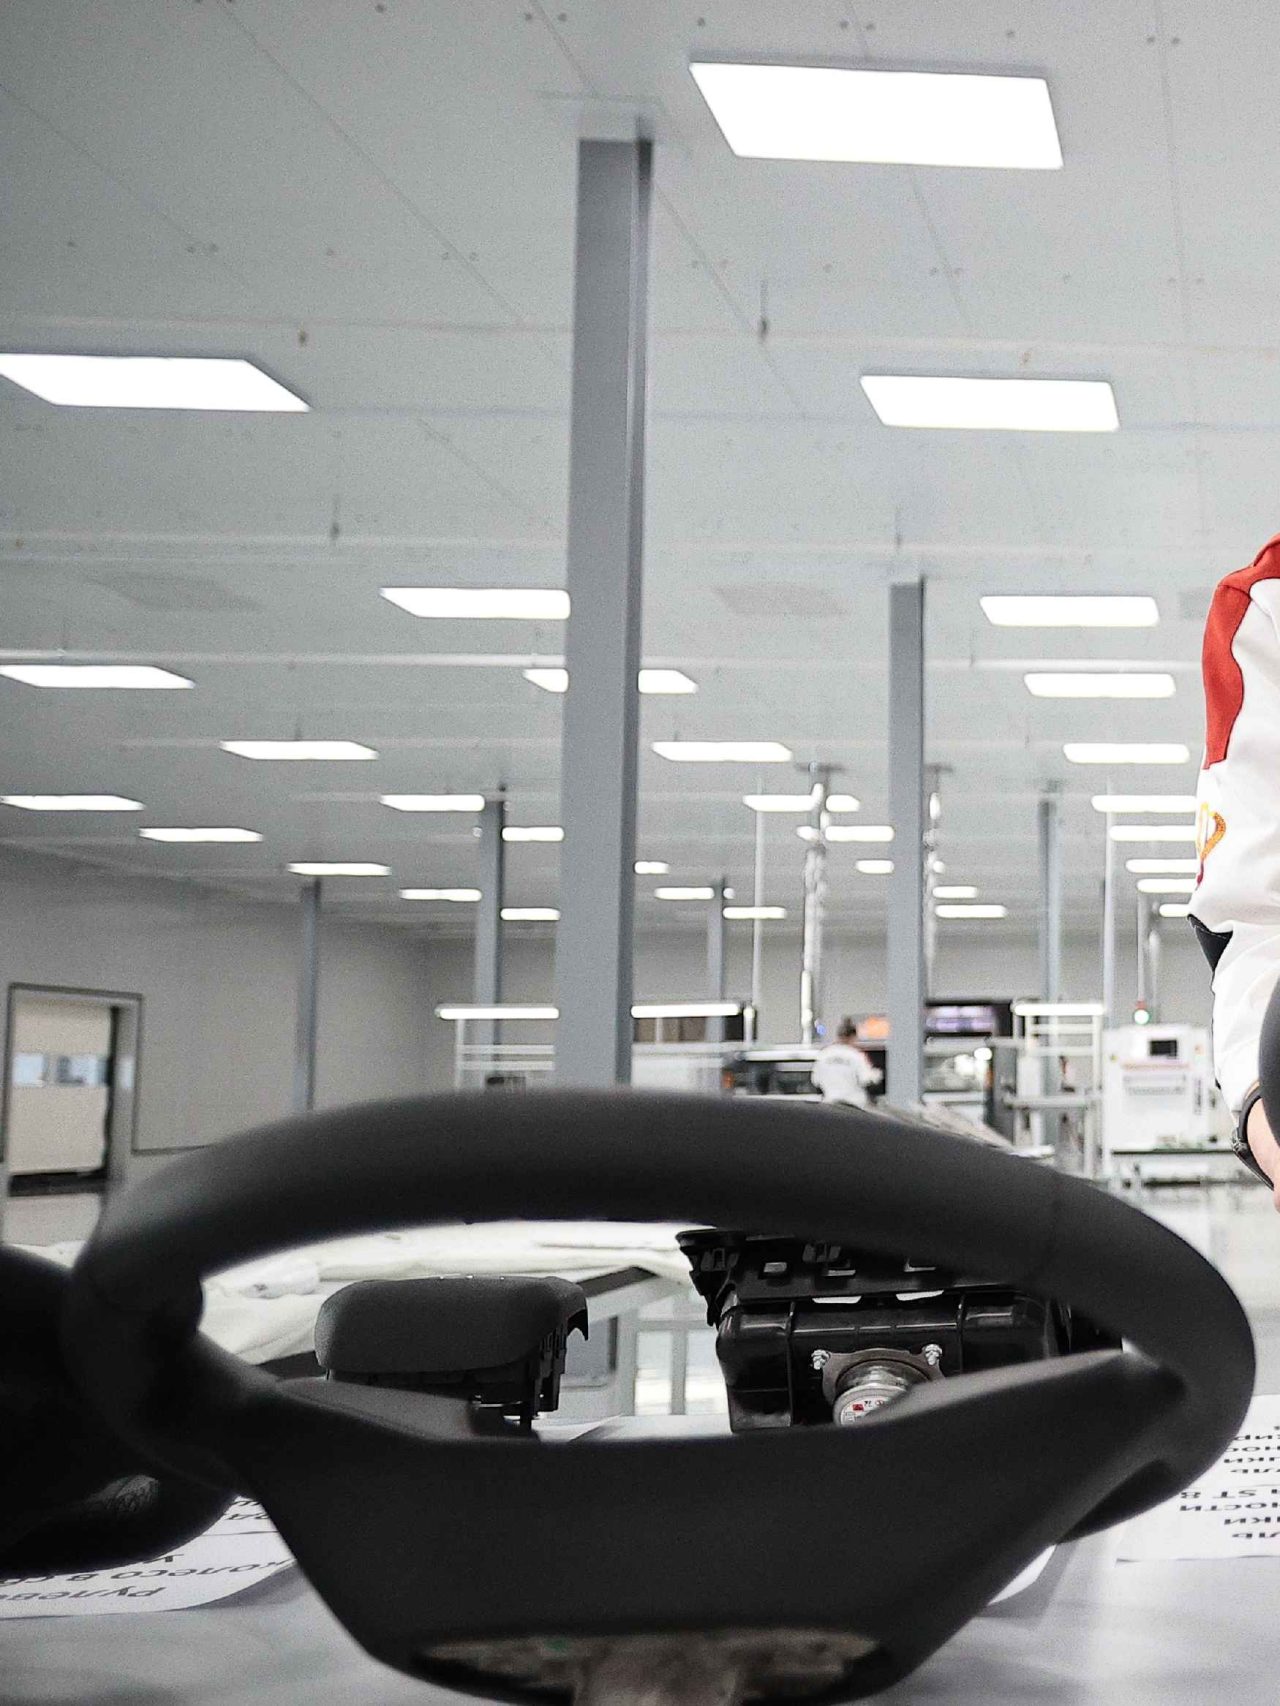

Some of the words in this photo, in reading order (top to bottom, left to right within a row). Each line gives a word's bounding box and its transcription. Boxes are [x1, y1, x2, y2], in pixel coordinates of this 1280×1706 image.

[1181, 1491, 1202, 1499] 8
[1211, 1490, 1257, 1499] ST
[110, 1560, 290, 1580] колесо
